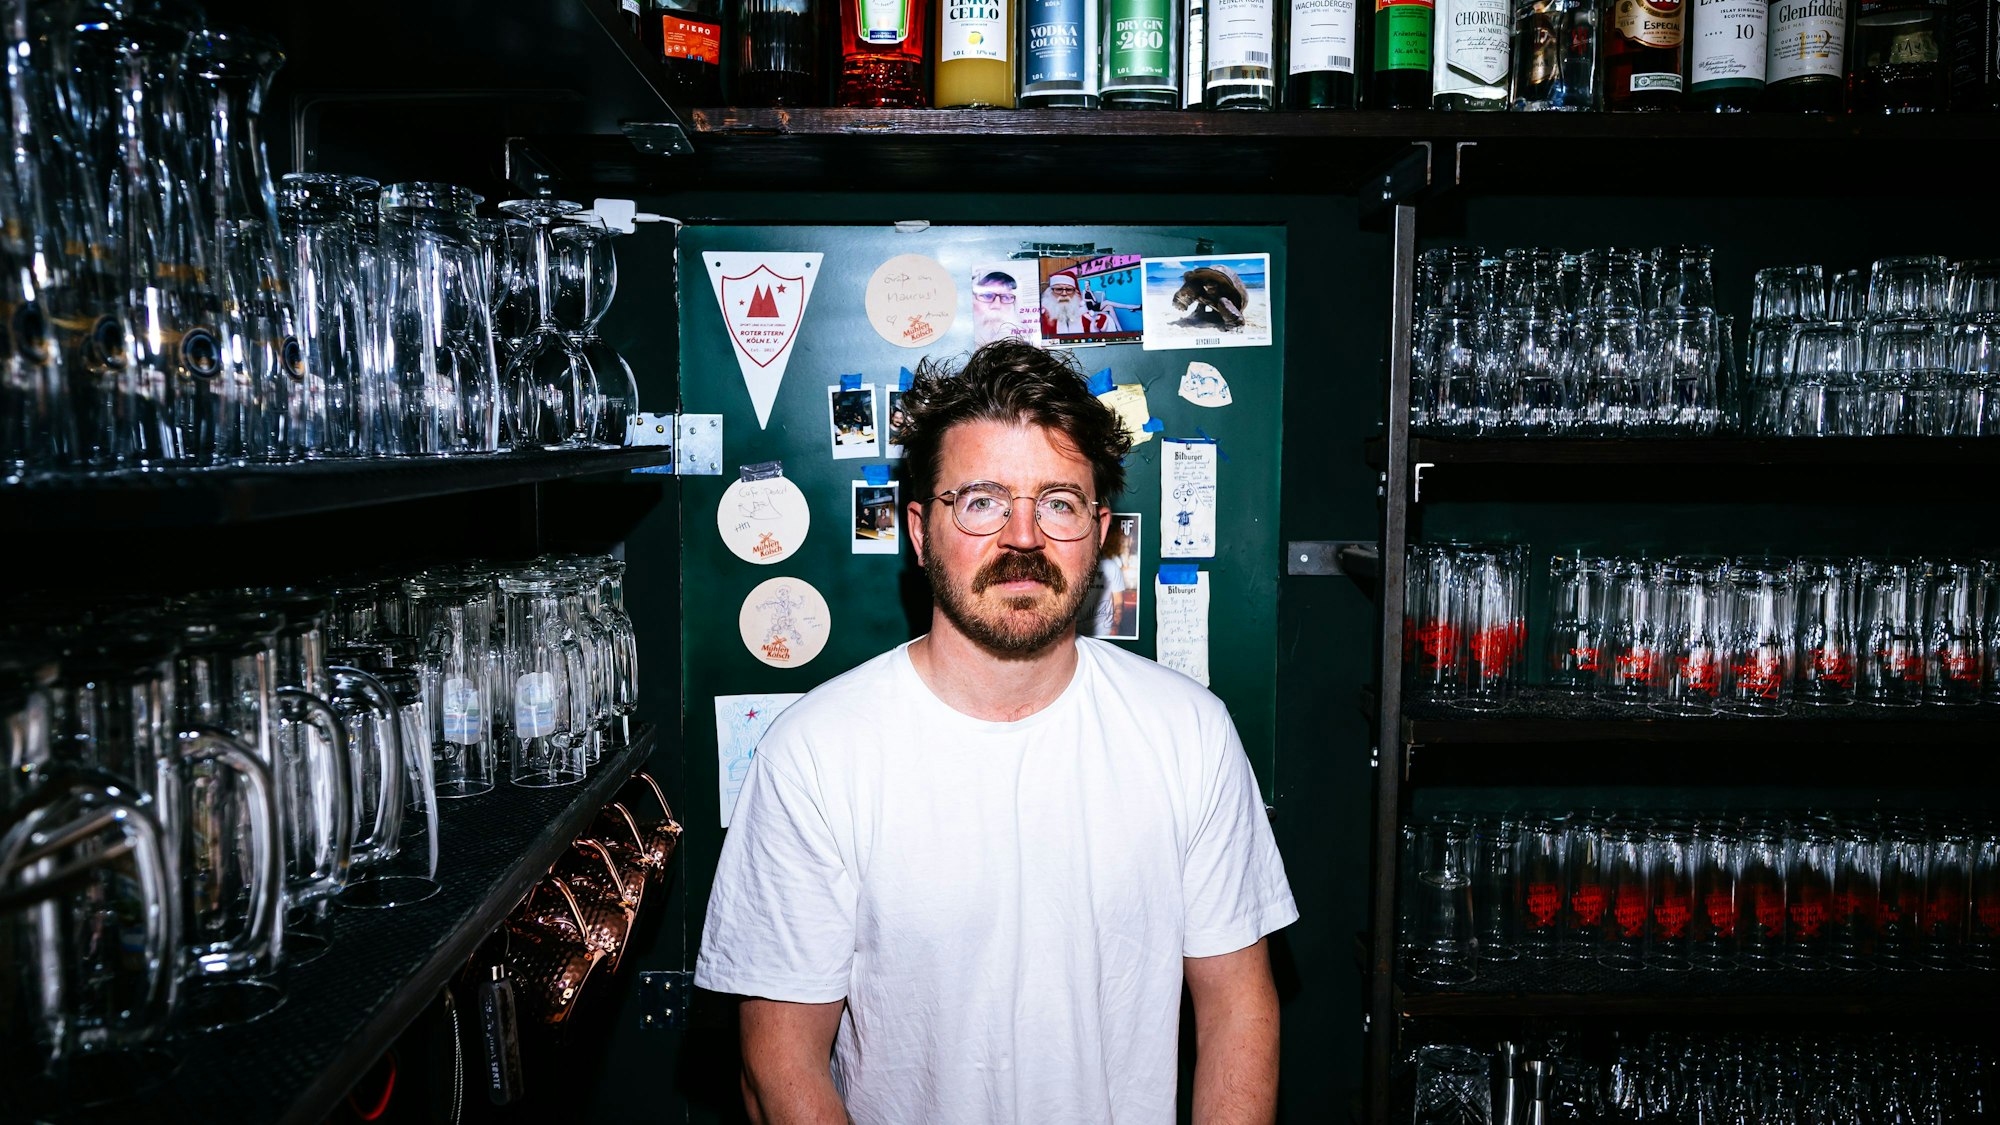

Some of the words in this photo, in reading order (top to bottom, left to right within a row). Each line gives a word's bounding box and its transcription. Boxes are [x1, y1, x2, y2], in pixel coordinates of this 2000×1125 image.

[1295, 0, 1353, 10] WACHOLDERGEIST
[949, 7, 1000, 20] CELLO
[1779, 0, 1845, 23] Glenfiddich
[679, 23, 711, 35] FIERO
[1116, 20, 1139, 32] DRY
[1142, 20, 1163, 31] GIN
[1478, 26, 1502, 35] KÜMMEL
[1643, 20, 1680, 31] ESPECIAL
[1735, 23, 1755, 40] 10
[1030, 25, 1078, 39] VODKA
[1030, 37, 1078, 49] COLONIA
[1120, 30, 1164, 50] 260
[1100, 269, 1134, 289] 2023
[1195, 337, 1221, 346] SEYCHELLES
[1174, 451, 1203, 461] Bitburger
[1167, 585, 1196, 595] Bitburger
